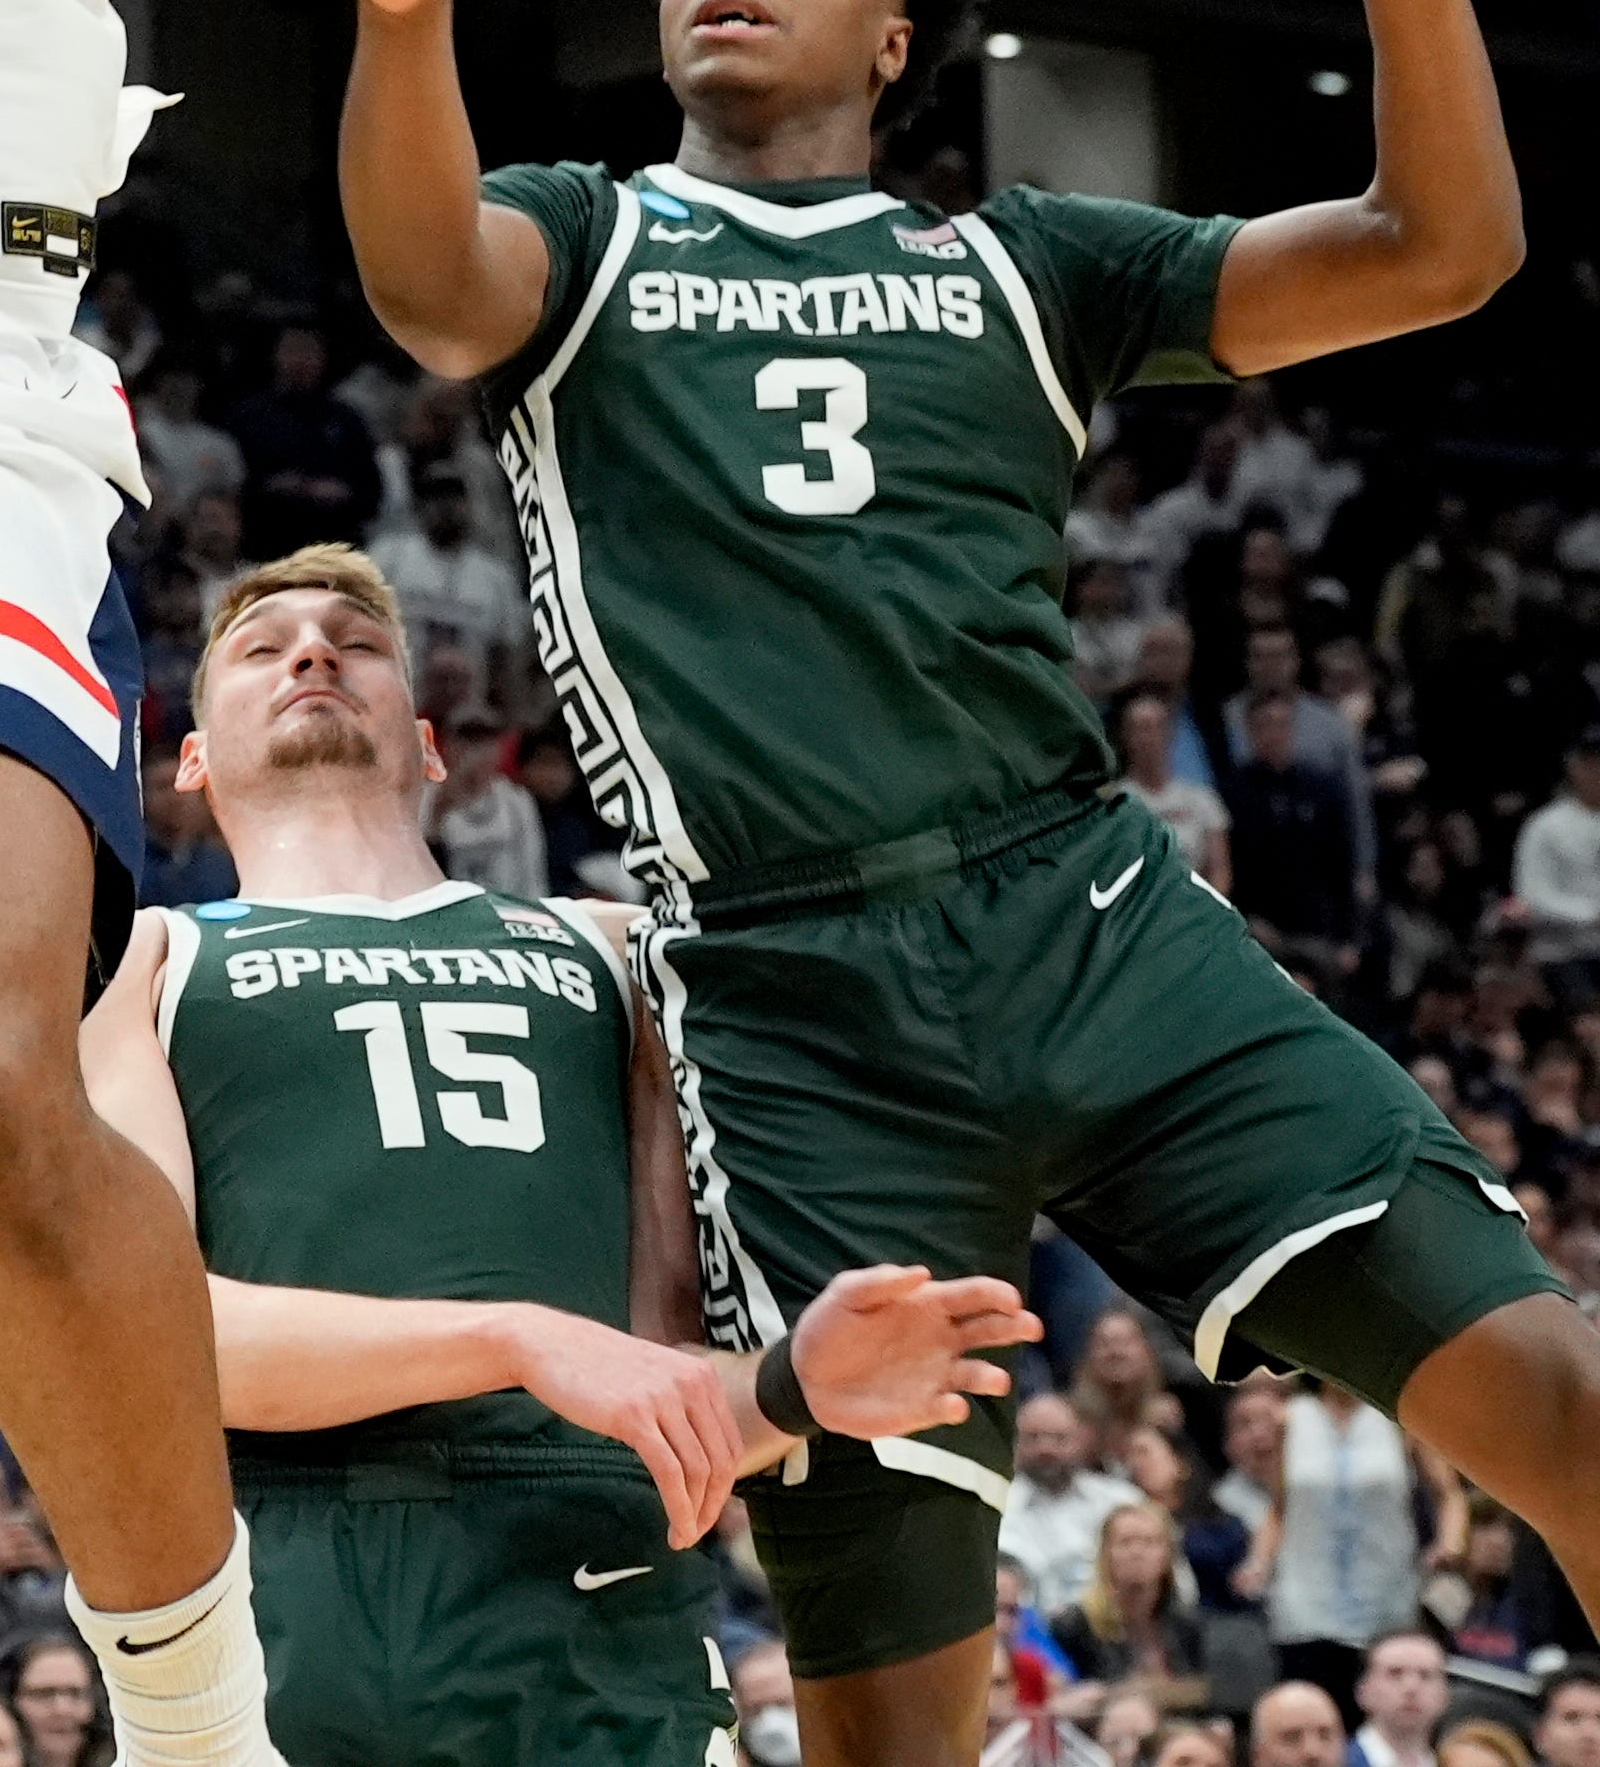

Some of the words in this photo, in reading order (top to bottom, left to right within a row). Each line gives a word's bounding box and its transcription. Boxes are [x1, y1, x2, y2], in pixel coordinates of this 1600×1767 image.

[629, 270, 985, 340] SPARTANS
[754, 357, 876, 515] 3
[226, 946, 597, 1012] SPARTANS
[334, 1000, 546, 1153] 15
